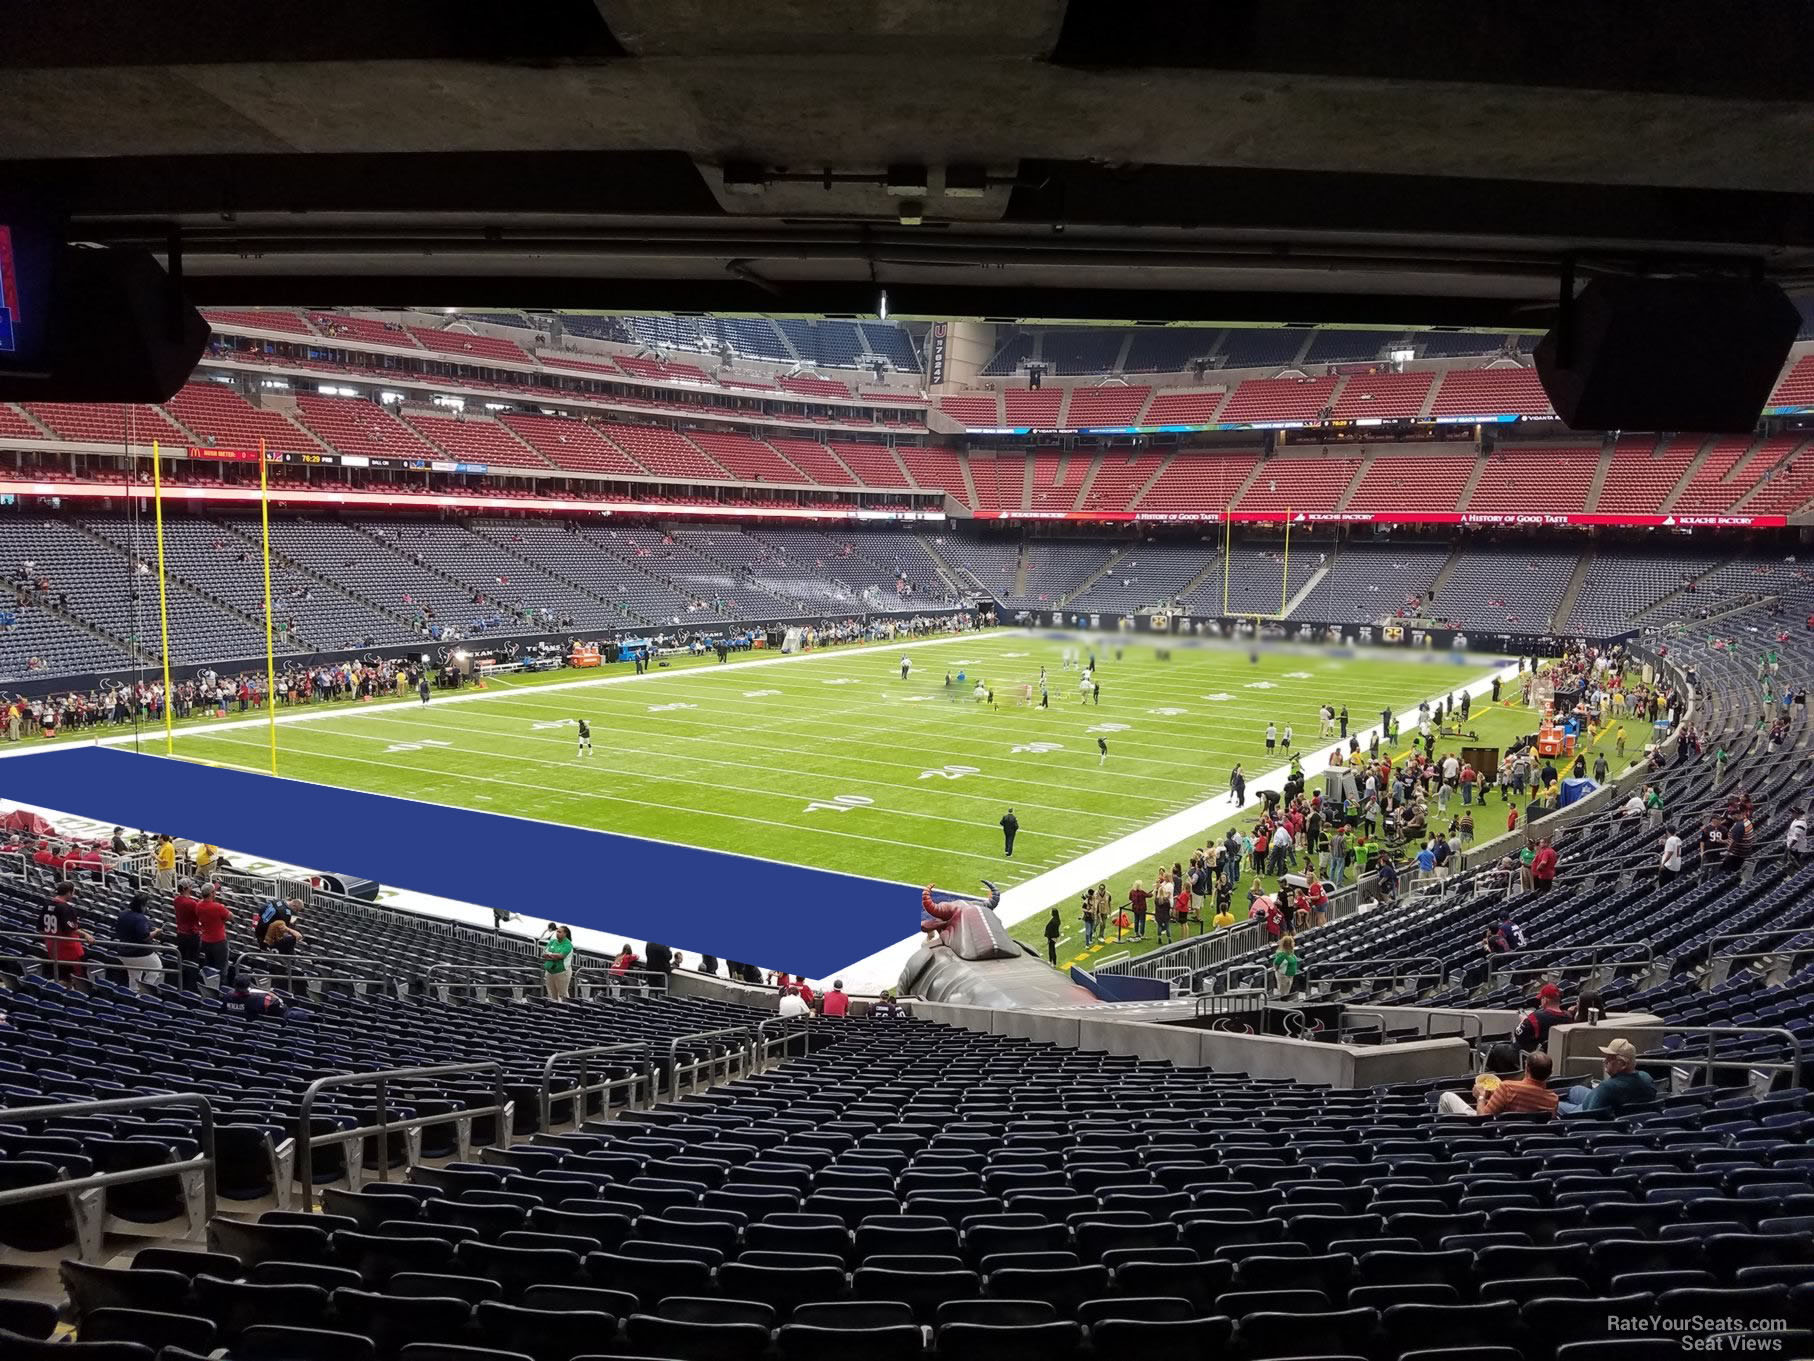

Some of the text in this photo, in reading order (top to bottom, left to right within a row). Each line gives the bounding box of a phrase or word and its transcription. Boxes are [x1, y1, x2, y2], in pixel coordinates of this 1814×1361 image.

[1544, 515, 1568, 523] TASTE
[526, 643, 562, 653] TEANS
[917, 765, 982, 780] 20
[803, 795, 875, 813] 10
[1709, 831, 1723, 842] 99
[43, 914, 59, 937] 99
